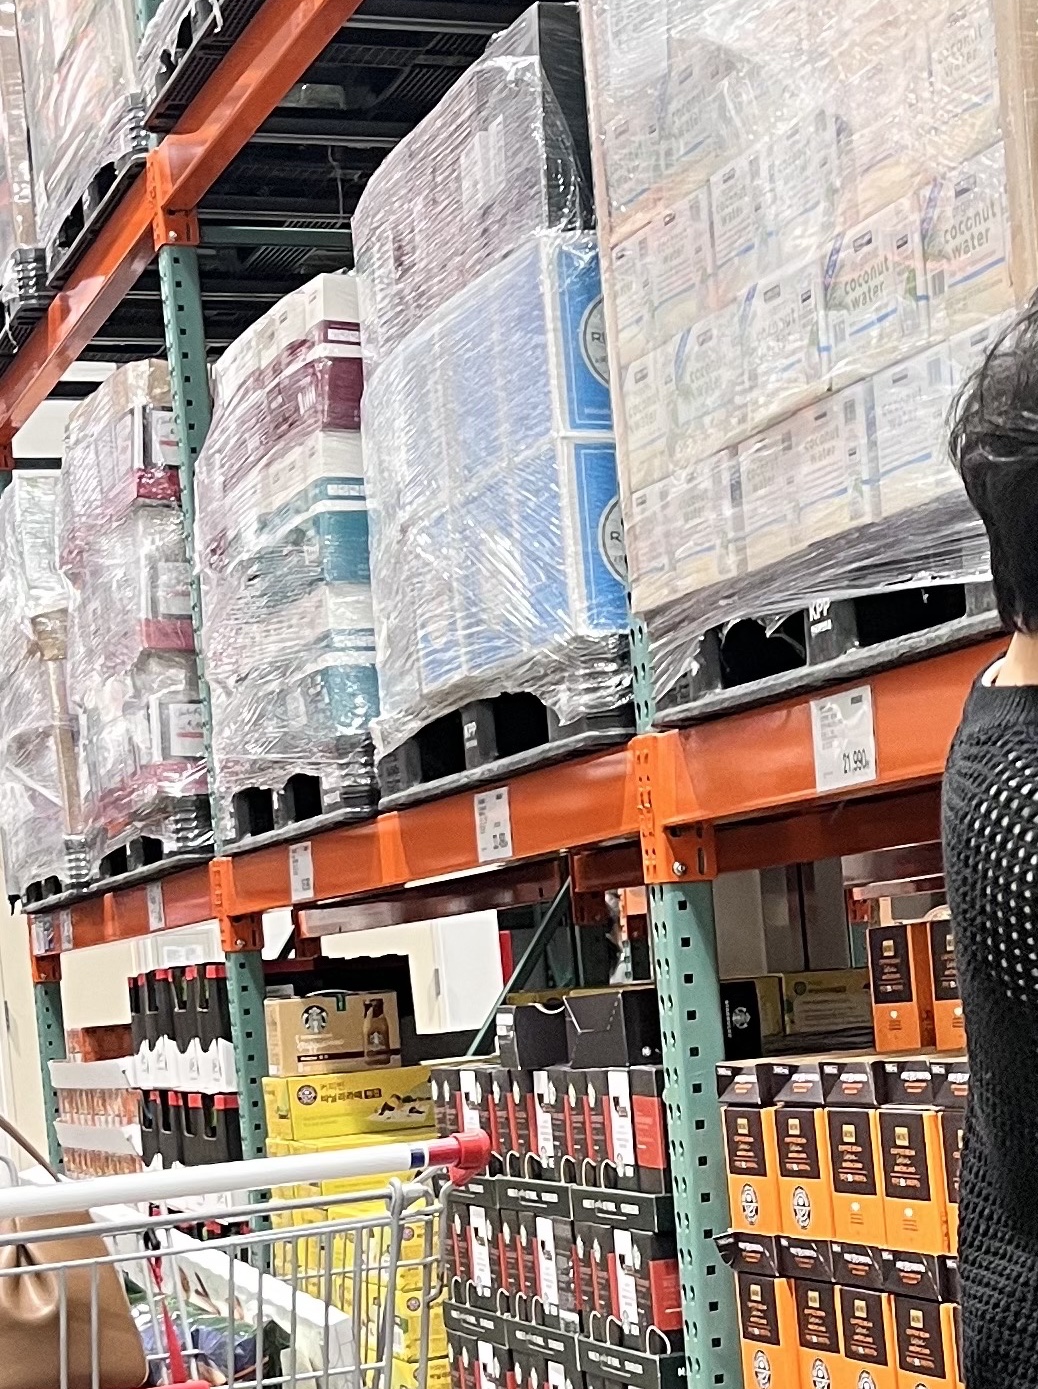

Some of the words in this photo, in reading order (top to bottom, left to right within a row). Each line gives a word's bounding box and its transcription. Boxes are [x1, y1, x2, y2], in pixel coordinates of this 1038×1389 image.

[944, 199, 997, 244] coconut
[952, 227, 990, 260] water
[843, 254, 890, 296] coconut
[850, 280, 885, 312] water
